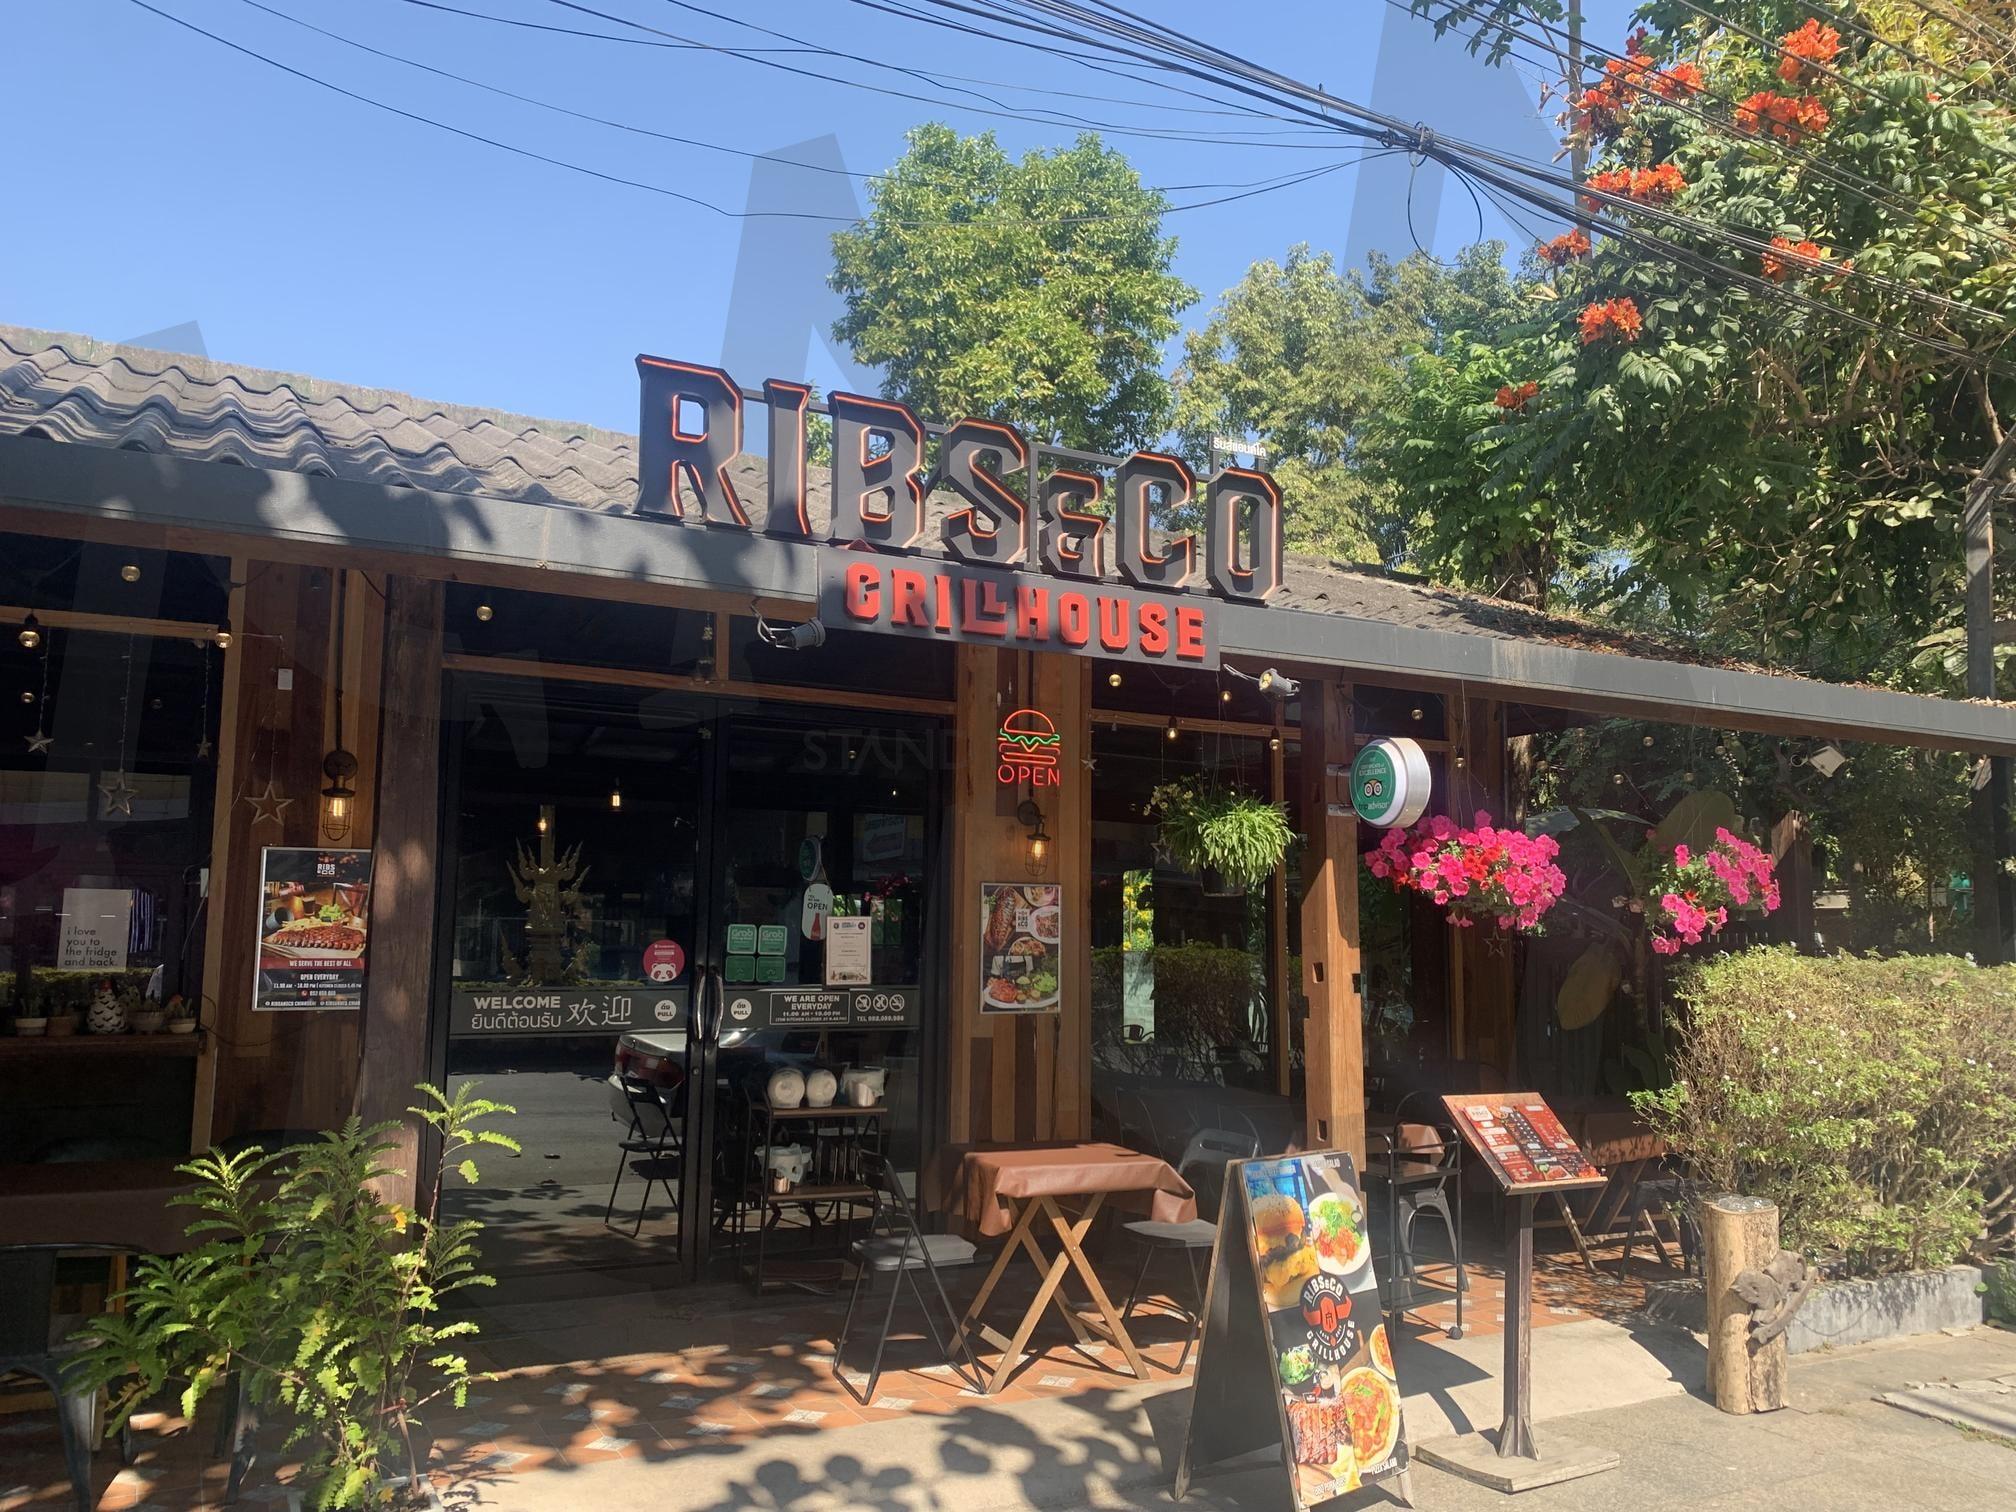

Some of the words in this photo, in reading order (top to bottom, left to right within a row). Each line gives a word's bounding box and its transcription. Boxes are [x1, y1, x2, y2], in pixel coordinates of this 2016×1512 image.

[635, 353, 1284, 602] RIBS&CO
[997, 764, 1060, 787] OPEN
[807, 902, 828, 911] OPEN
[74, 926, 97, 936] love
[732, 928, 753, 937] Grab
[762, 930, 783, 938] Grab
[66, 938, 86, 947] you
[89, 937, 100, 946] to
[65, 946, 82, 957] the
[86, 946, 117, 958] fridge
[64, 957, 85, 967] and
[473, 995, 561, 1009] WELCOME
[566, 995, 632, 1026] 欢迎
[471, 1011, 562, 1029] ยินดีต้อนรับ
